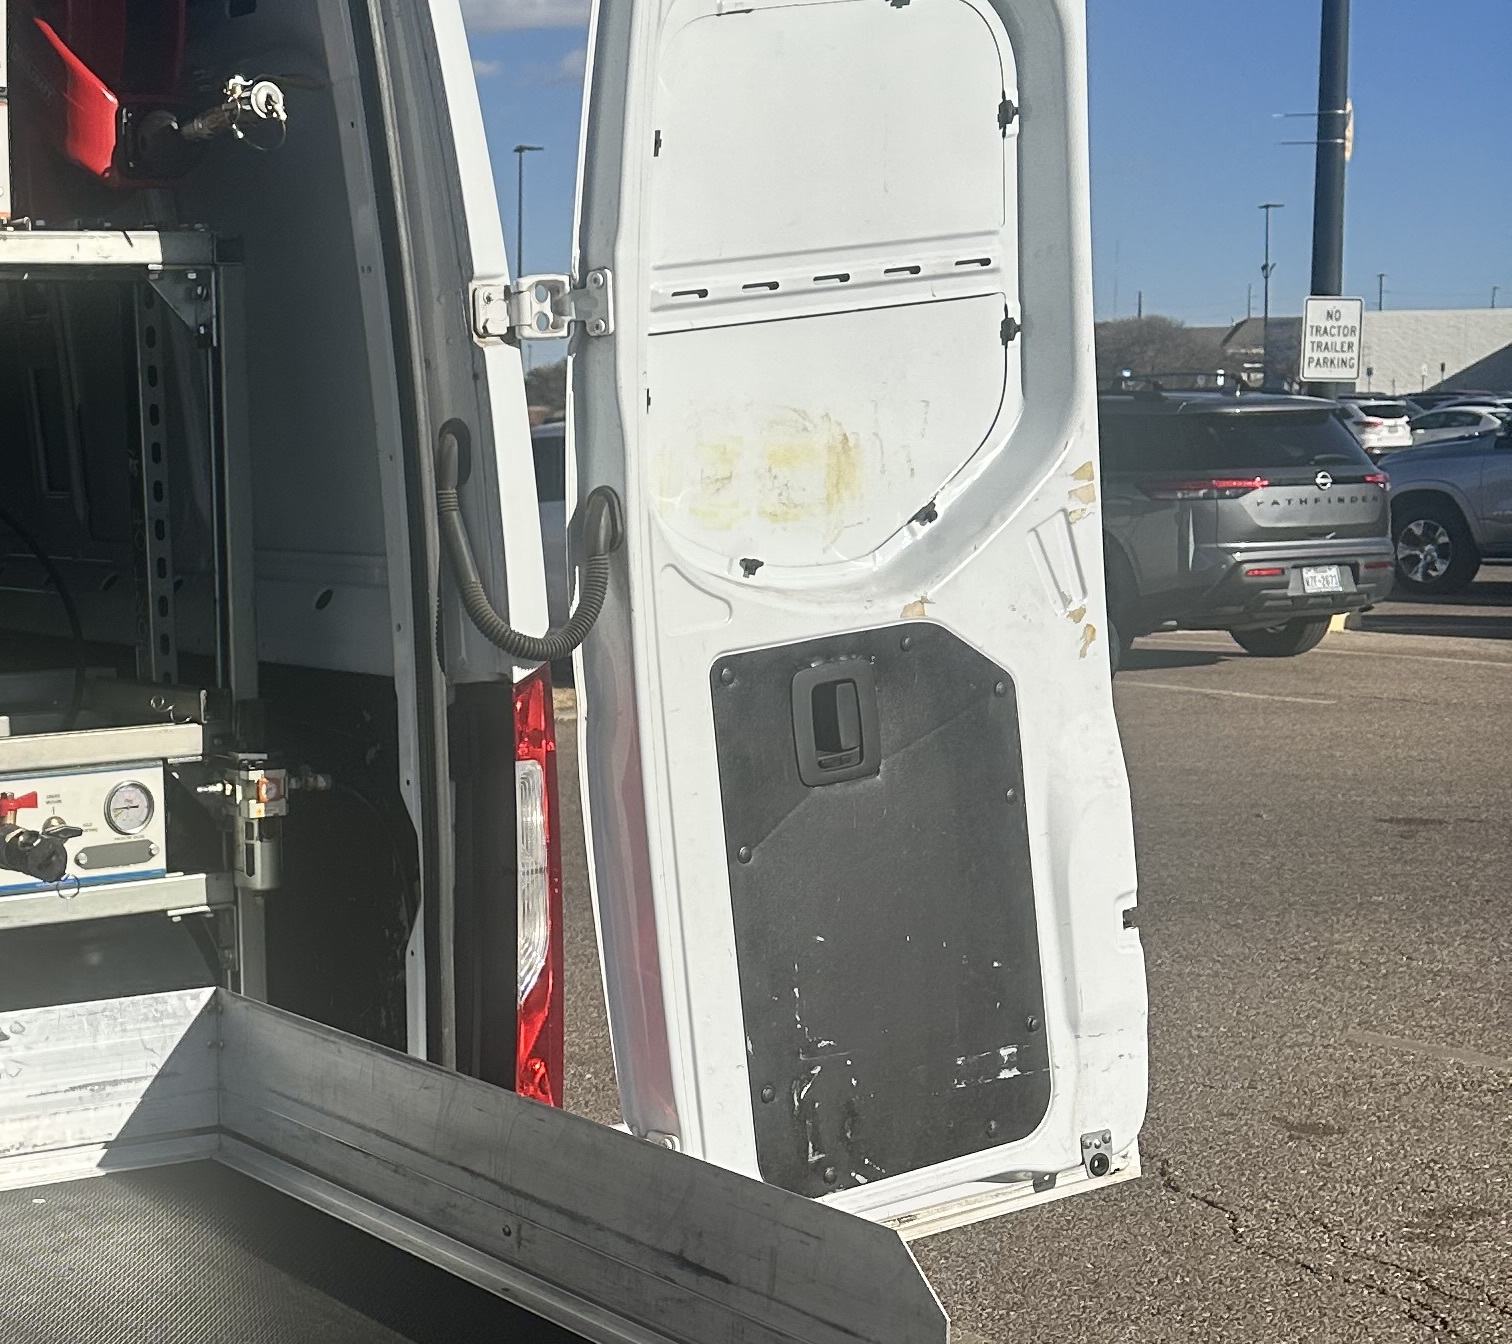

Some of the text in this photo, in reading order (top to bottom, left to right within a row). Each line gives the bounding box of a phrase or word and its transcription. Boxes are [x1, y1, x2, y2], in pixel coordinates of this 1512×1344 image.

[1326, 309, 1342, 322] NO
[1309, 324, 1357, 337] TRACTOR
[1310, 340, 1355, 353] TRAILER
[1307, 357, 1356, 369] PARKING
[1256, 496, 1379, 507] PATHFINDER
